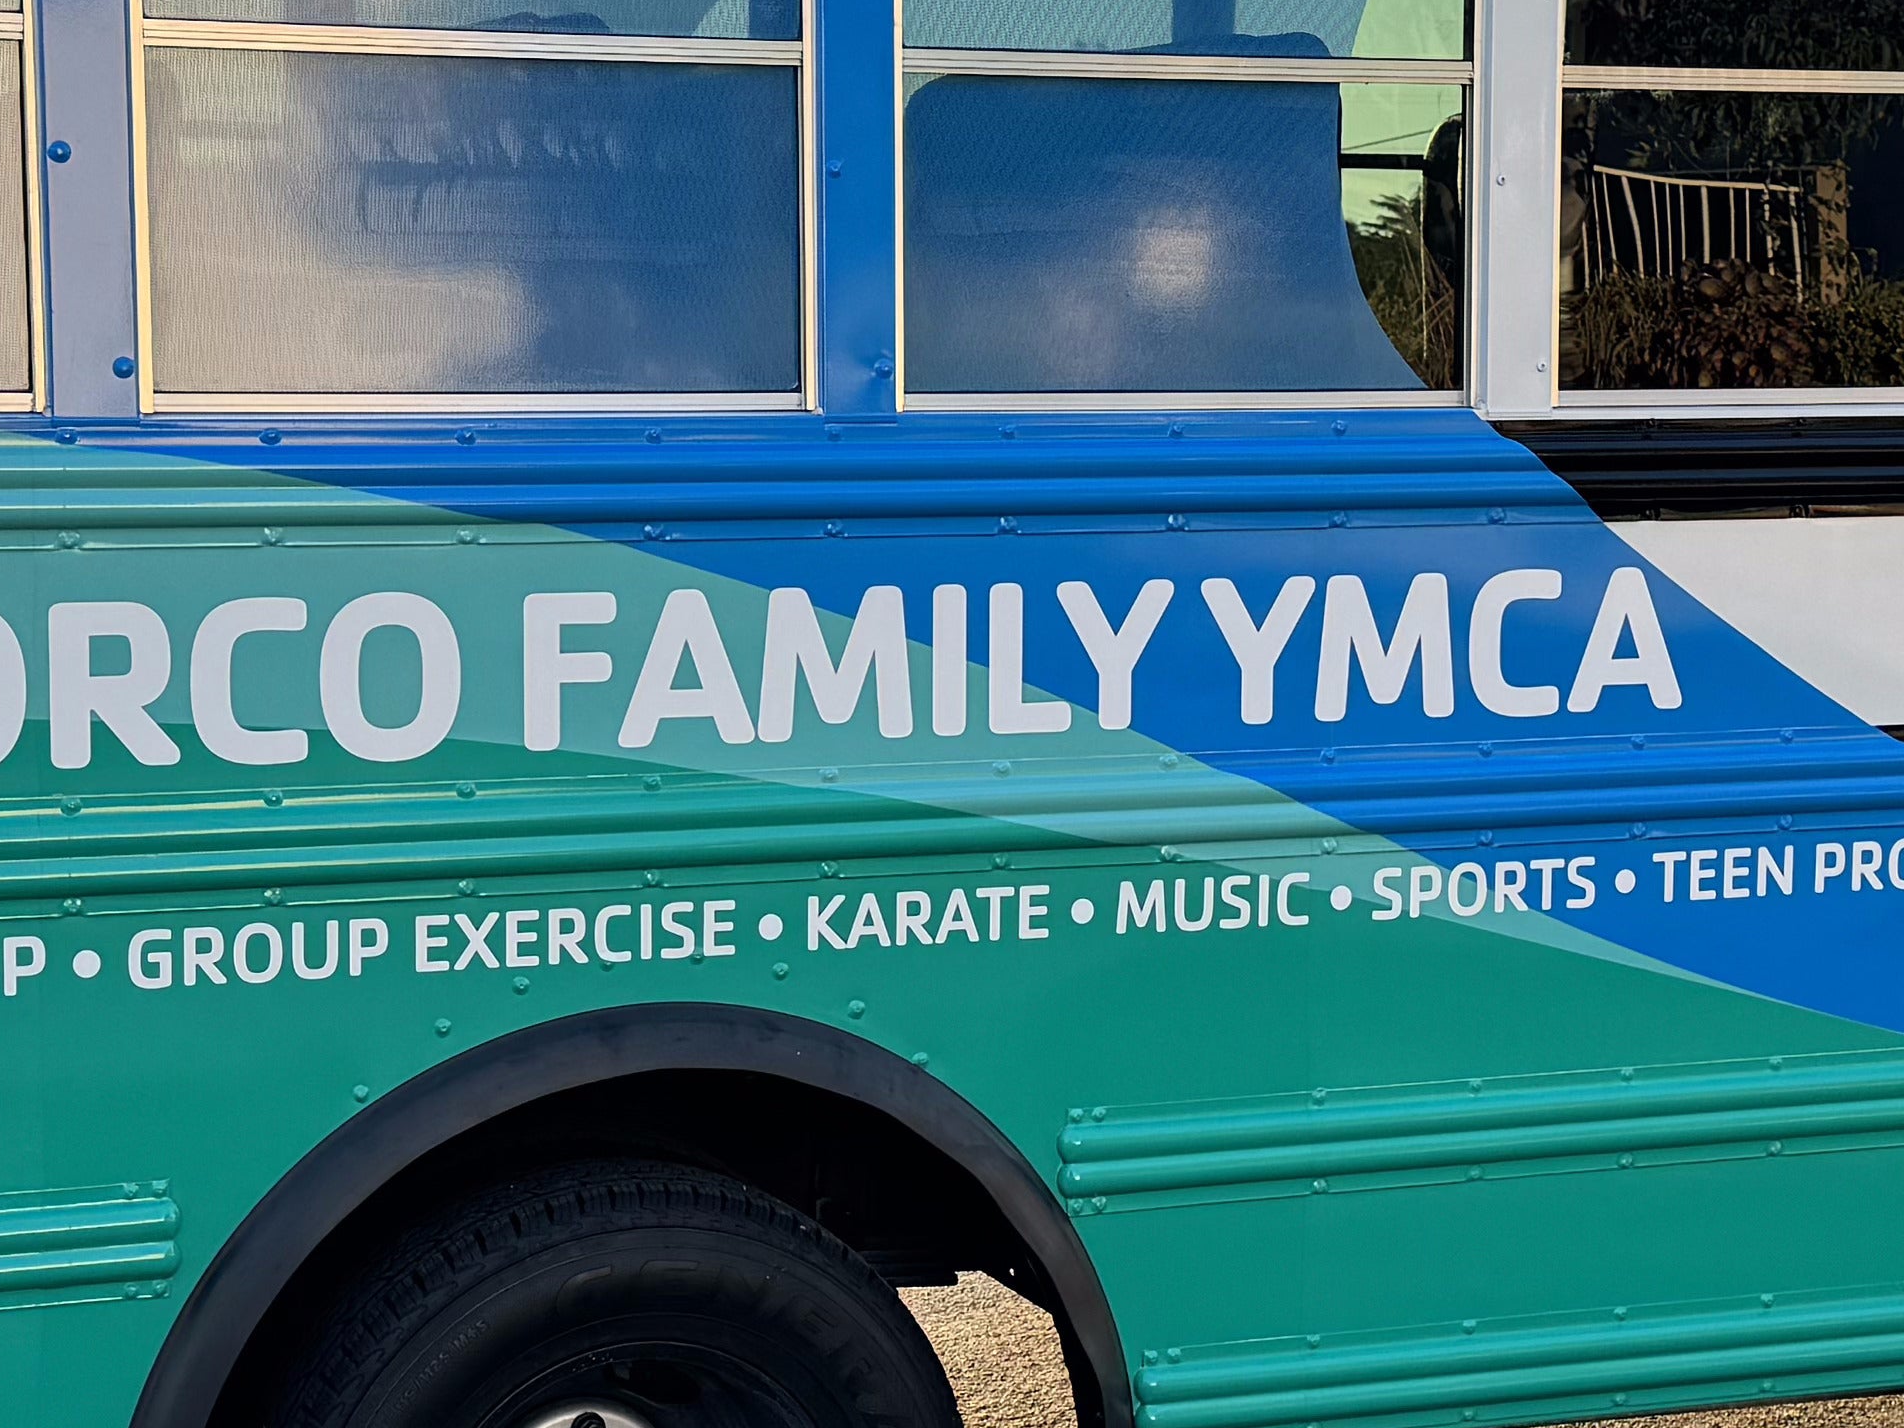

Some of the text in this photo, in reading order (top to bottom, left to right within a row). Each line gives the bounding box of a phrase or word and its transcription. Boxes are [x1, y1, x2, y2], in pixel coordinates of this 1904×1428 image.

[523, 579, 1175, 752] FAMILY
[1200, 566, 1683, 725] YMCA
[128, 918, 389, 990] GROUP
[415, 899, 736, 973] EXERCISE
[807, 884, 1050, 951] KARATE
[1116, 872, 1310, 935] MUSIC
[1371, 856, 1596, 921] SPORTS
[1652, 845, 1794, 902] TEEN
